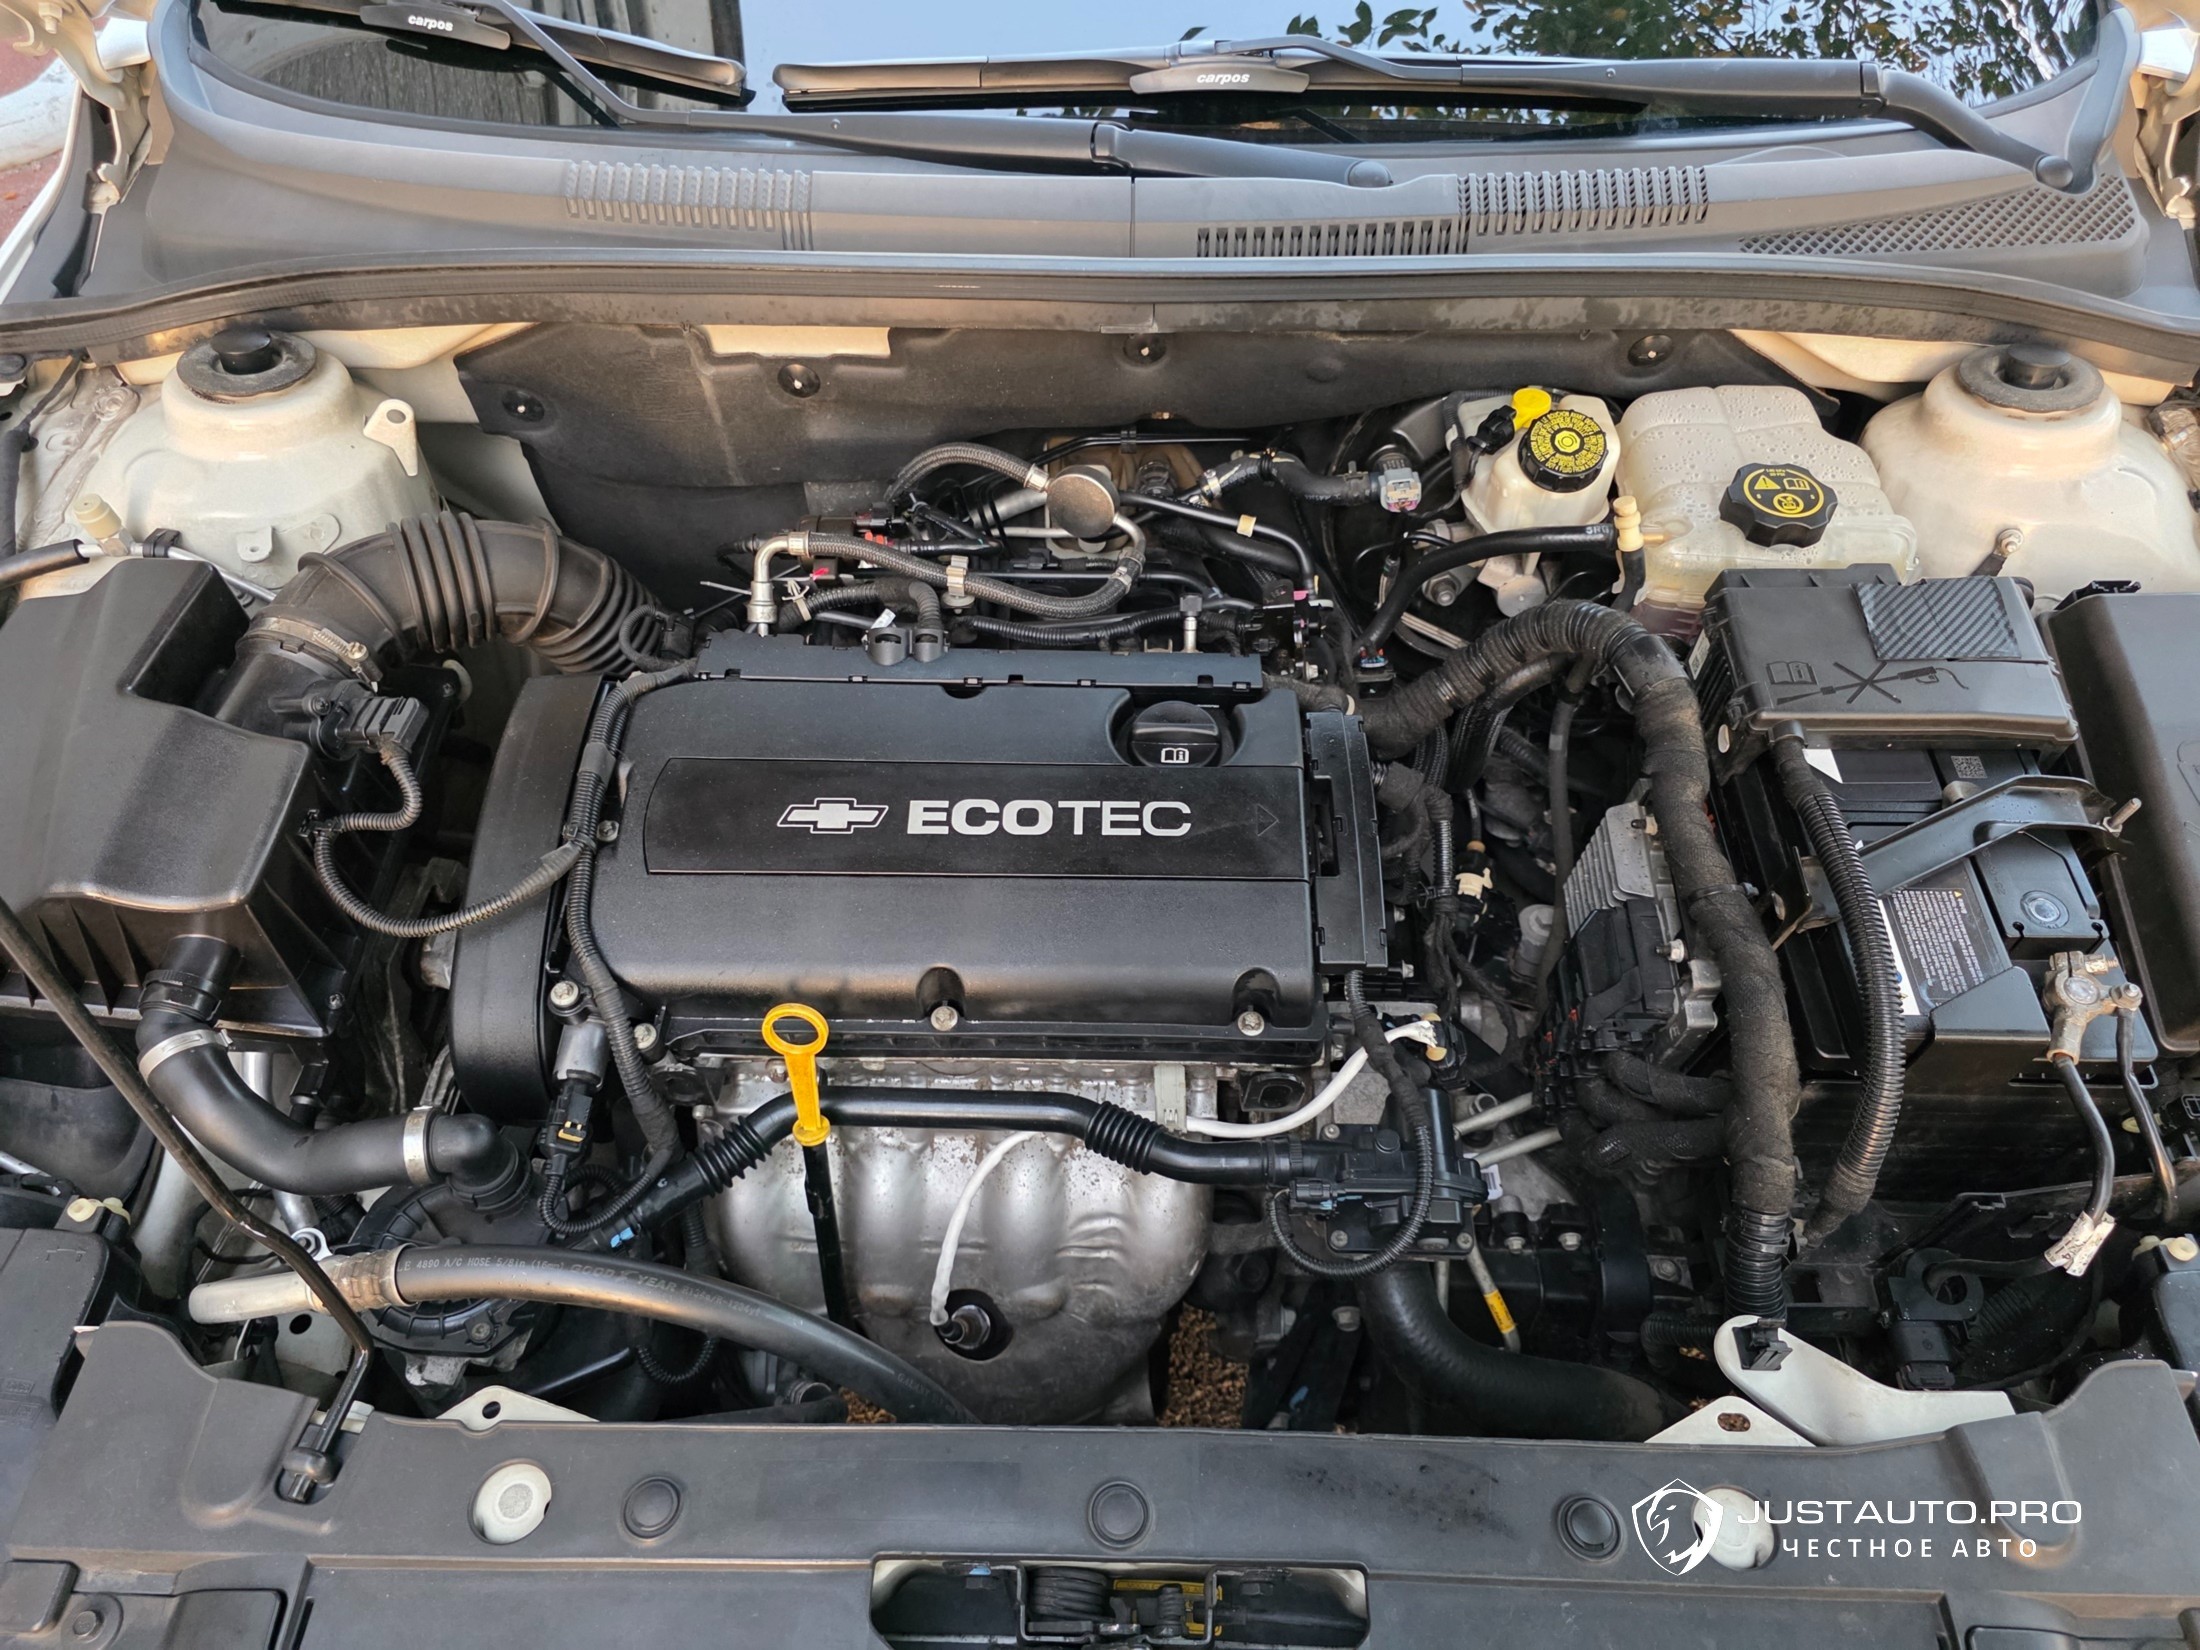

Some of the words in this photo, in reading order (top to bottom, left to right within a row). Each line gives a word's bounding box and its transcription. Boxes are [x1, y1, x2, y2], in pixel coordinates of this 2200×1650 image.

[408, 15, 454, 31] carpos
[1197, 72, 1250, 85] carpos
[906, 799, 1192, 837] ECOTEC
[416, 1258, 440, 1270] 4890
[444, 1257, 462, 1269] A/C
[468, 1257, 491, 1267] HOSE
